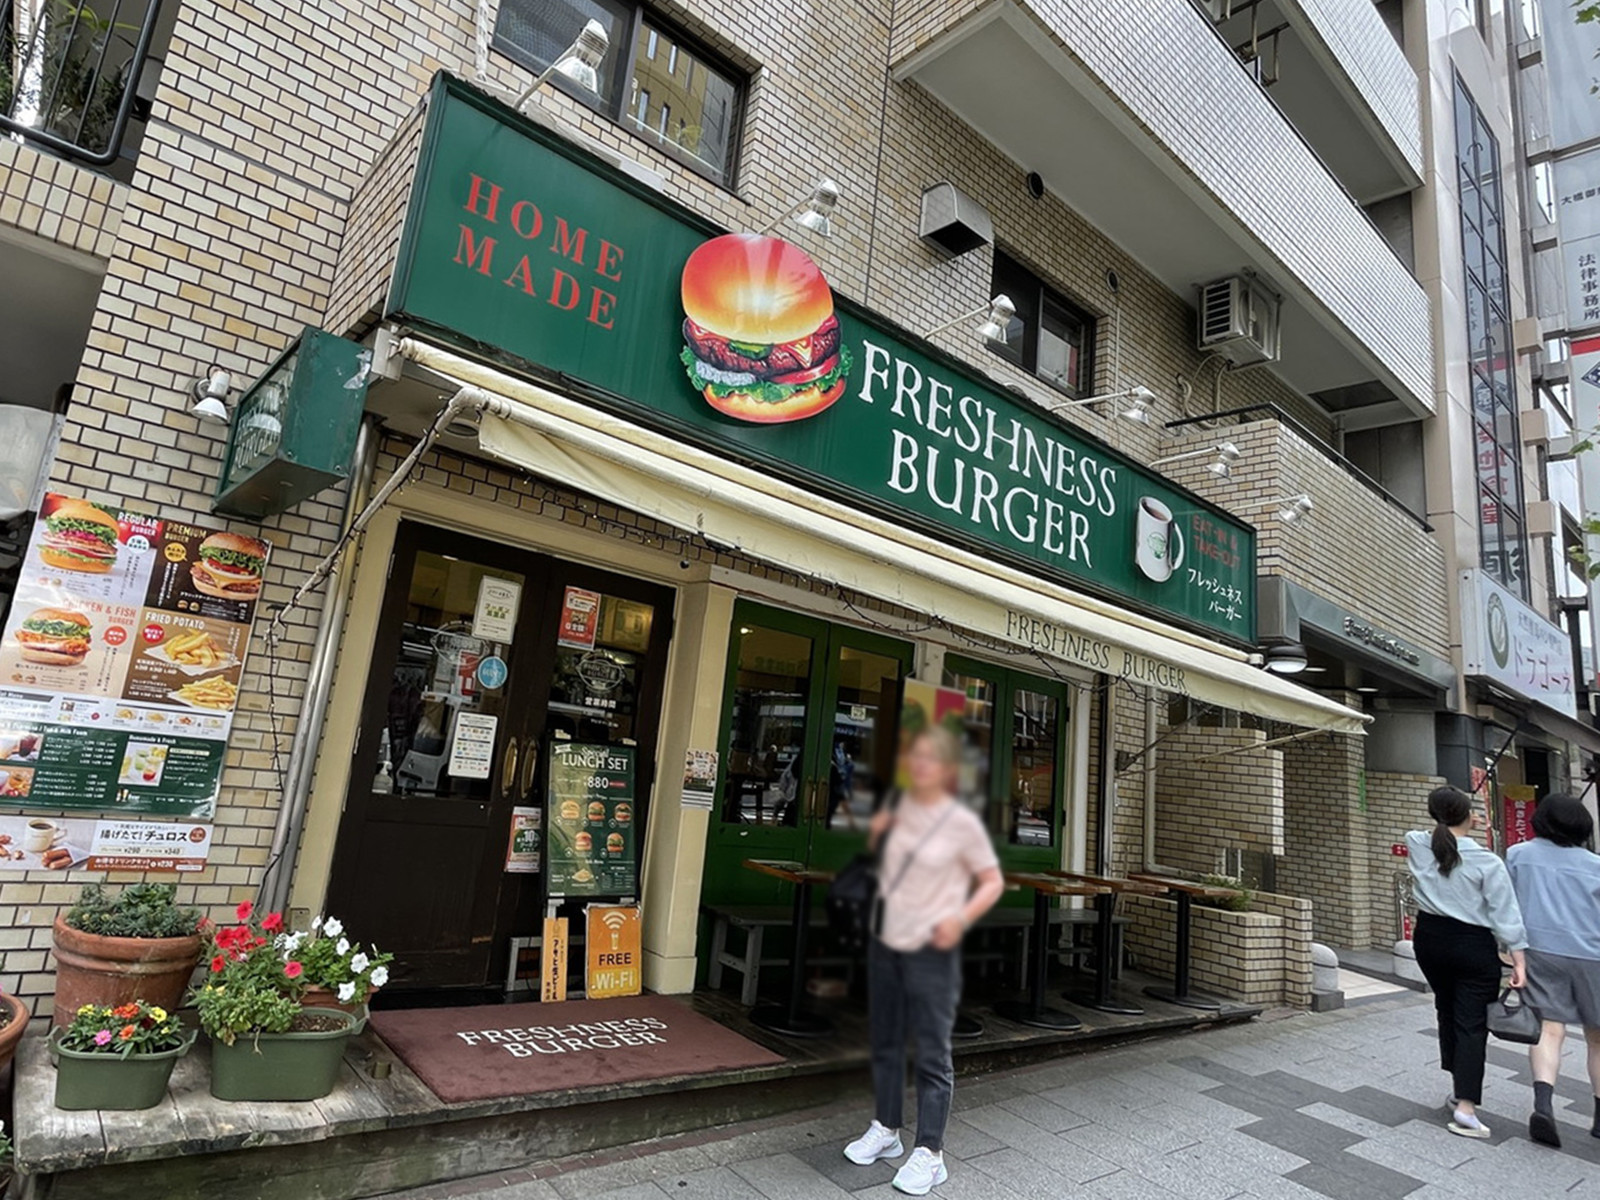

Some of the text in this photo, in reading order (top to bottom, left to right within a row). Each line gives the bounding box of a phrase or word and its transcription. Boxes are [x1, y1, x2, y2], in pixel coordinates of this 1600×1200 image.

[463, 172, 624, 282] HOME
[452, 224, 617, 330] MADE
[858, 340, 1116, 516] FRESHNESS
[887, 429, 1092, 568] BURGER
[118, 512, 159, 529] REGULAR
[167, 522, 207, 538] PREMIUM
[131, 525, 156, 536] BURGER
[165, 532, 190, 543] BURGER
[1188, 568, 1243, 604] フレッシュネス
[105, 605, 112, 614] &
[115, 606, 137, 617] FISH
[1208, 601, 1243, 620] バーガー
[145, 612, 205, 629] FRIED POTATO
[1006, 610, 1187, 691] FRESHNESS BURGER
[562, 753, 628, 770] LUNCH SET
[598, 952, 633, 966] FREE
[457, 1017, 669, 1046] FRESHNESS
[503, 1031, 668, 1058] BURGER
